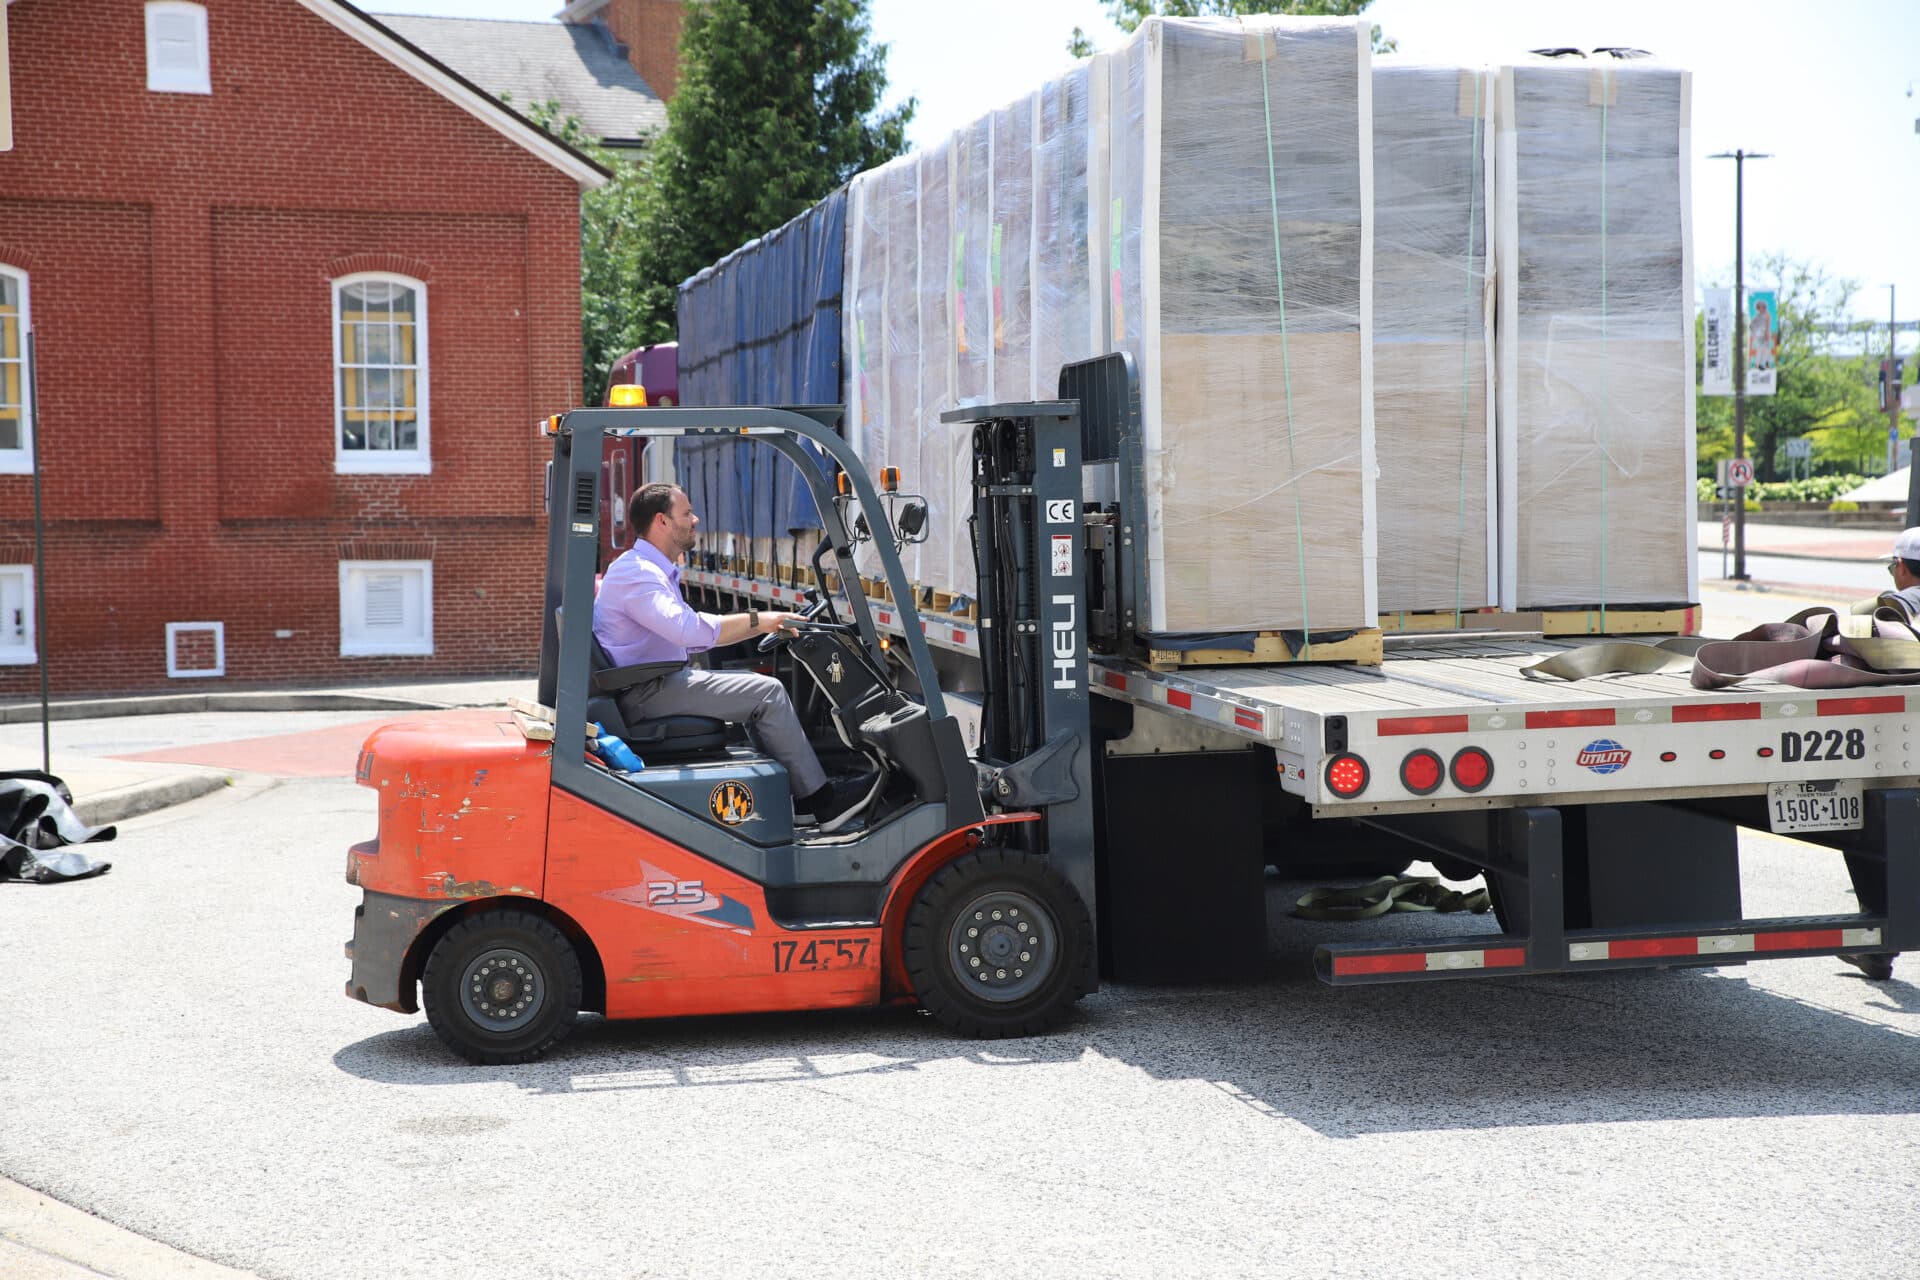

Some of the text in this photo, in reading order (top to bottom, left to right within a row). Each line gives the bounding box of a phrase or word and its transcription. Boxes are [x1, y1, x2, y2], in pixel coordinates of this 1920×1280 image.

[1707, 318, 1719, 369] WELCOME
[1048, 502, 1072, 520] CE
[1052, 594, 1076, 690] HELI
[1580, 751, 1628, 765] UTILITY
[1781, 728, 1866, 763] D228
[1775, 796, 1859, 823] 159C 108
[648, 880, 705, 905] 25
